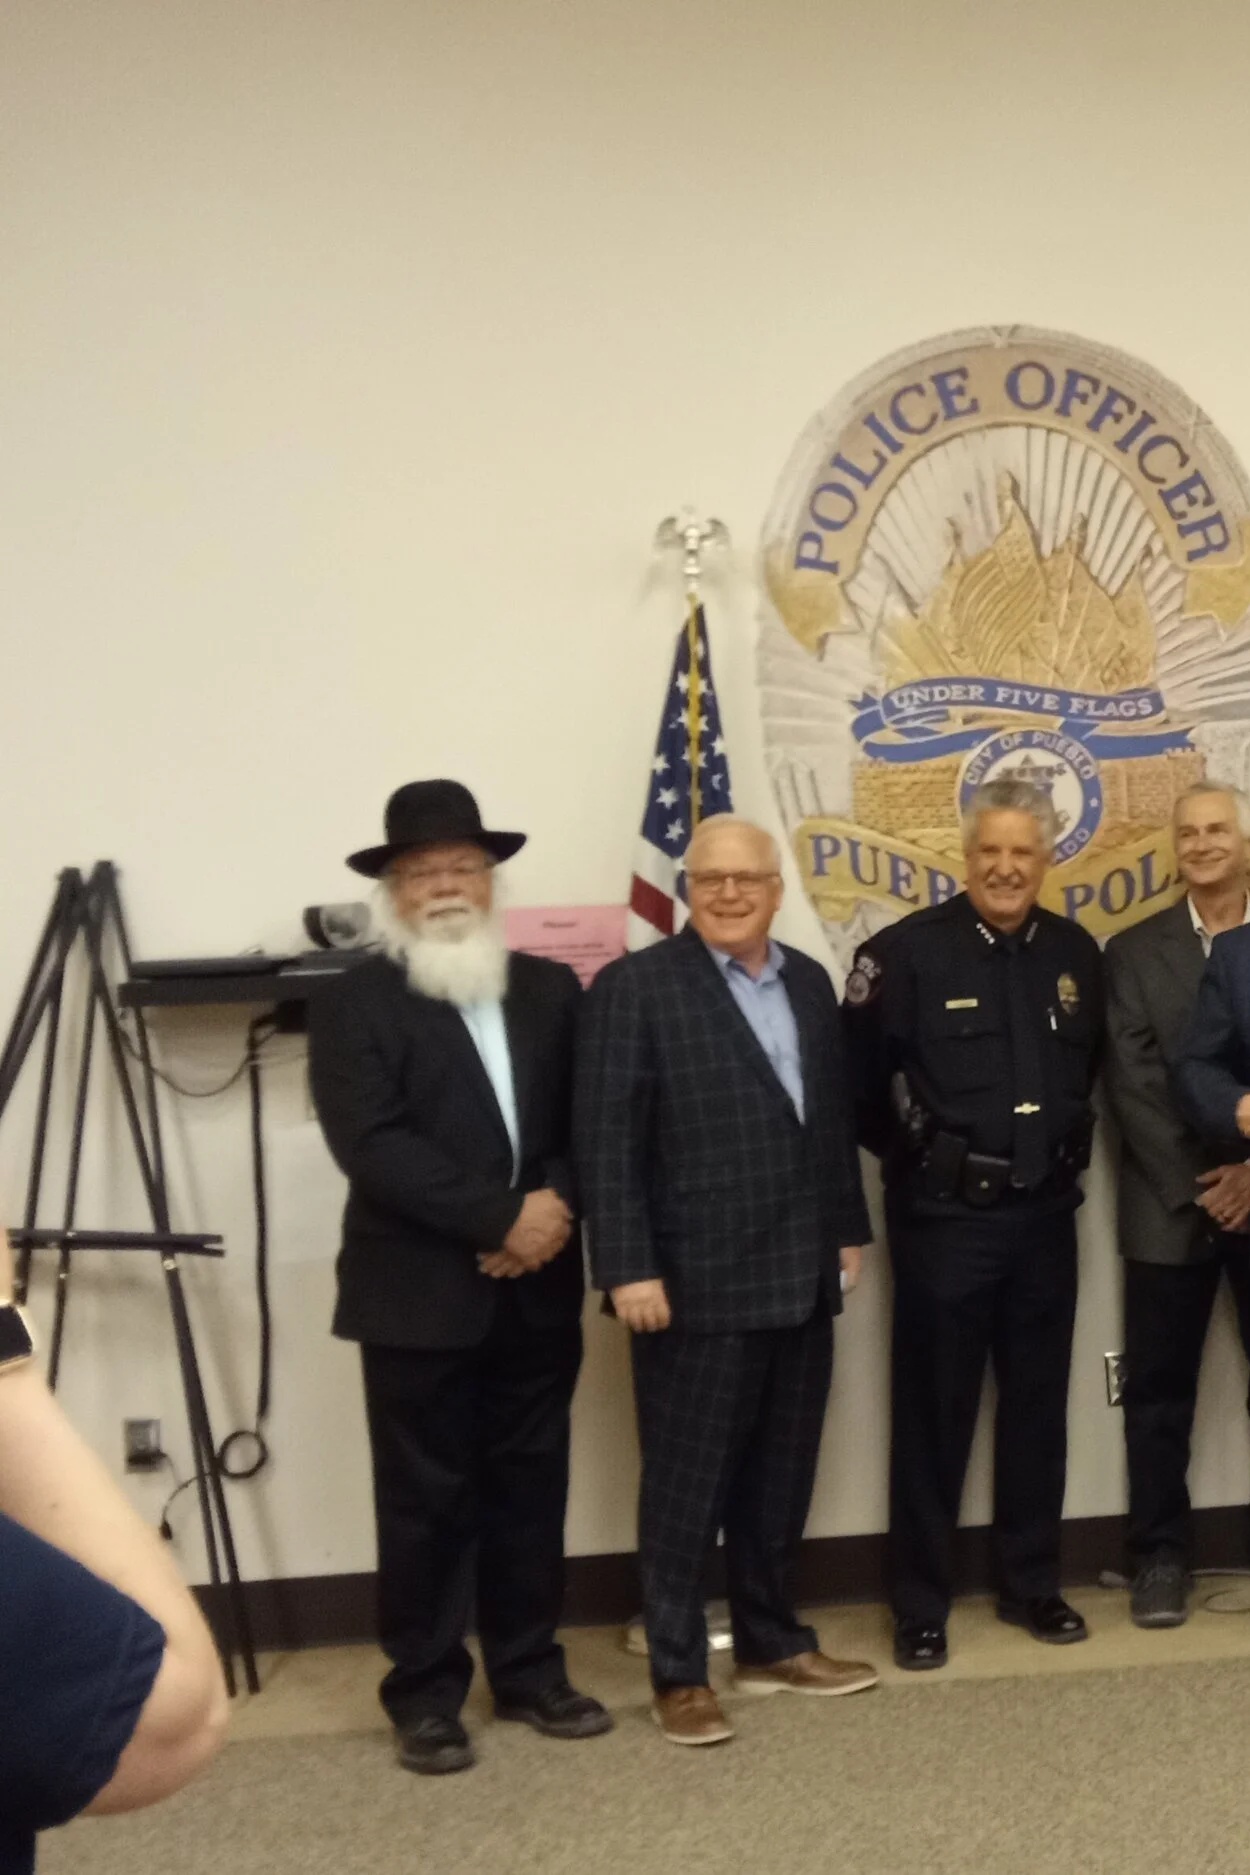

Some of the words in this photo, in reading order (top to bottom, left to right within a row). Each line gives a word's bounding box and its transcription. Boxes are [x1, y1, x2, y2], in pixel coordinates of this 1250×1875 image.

[794, 367, 979, 576] POLICE
[1005, 361, 1230, 565] OFFICER
[891, 684, 985, 710] UNDER
[996, 687, 1059, 710] FIVE
[1069, 697, 1153, 718] FLAGS
[964, 746, 993, 785] CITY
[1000, 732, 1023, 750] OF
[1032, 732, 1096, 780] PUEBLO
[808, 833, 958, 907] PUEB
